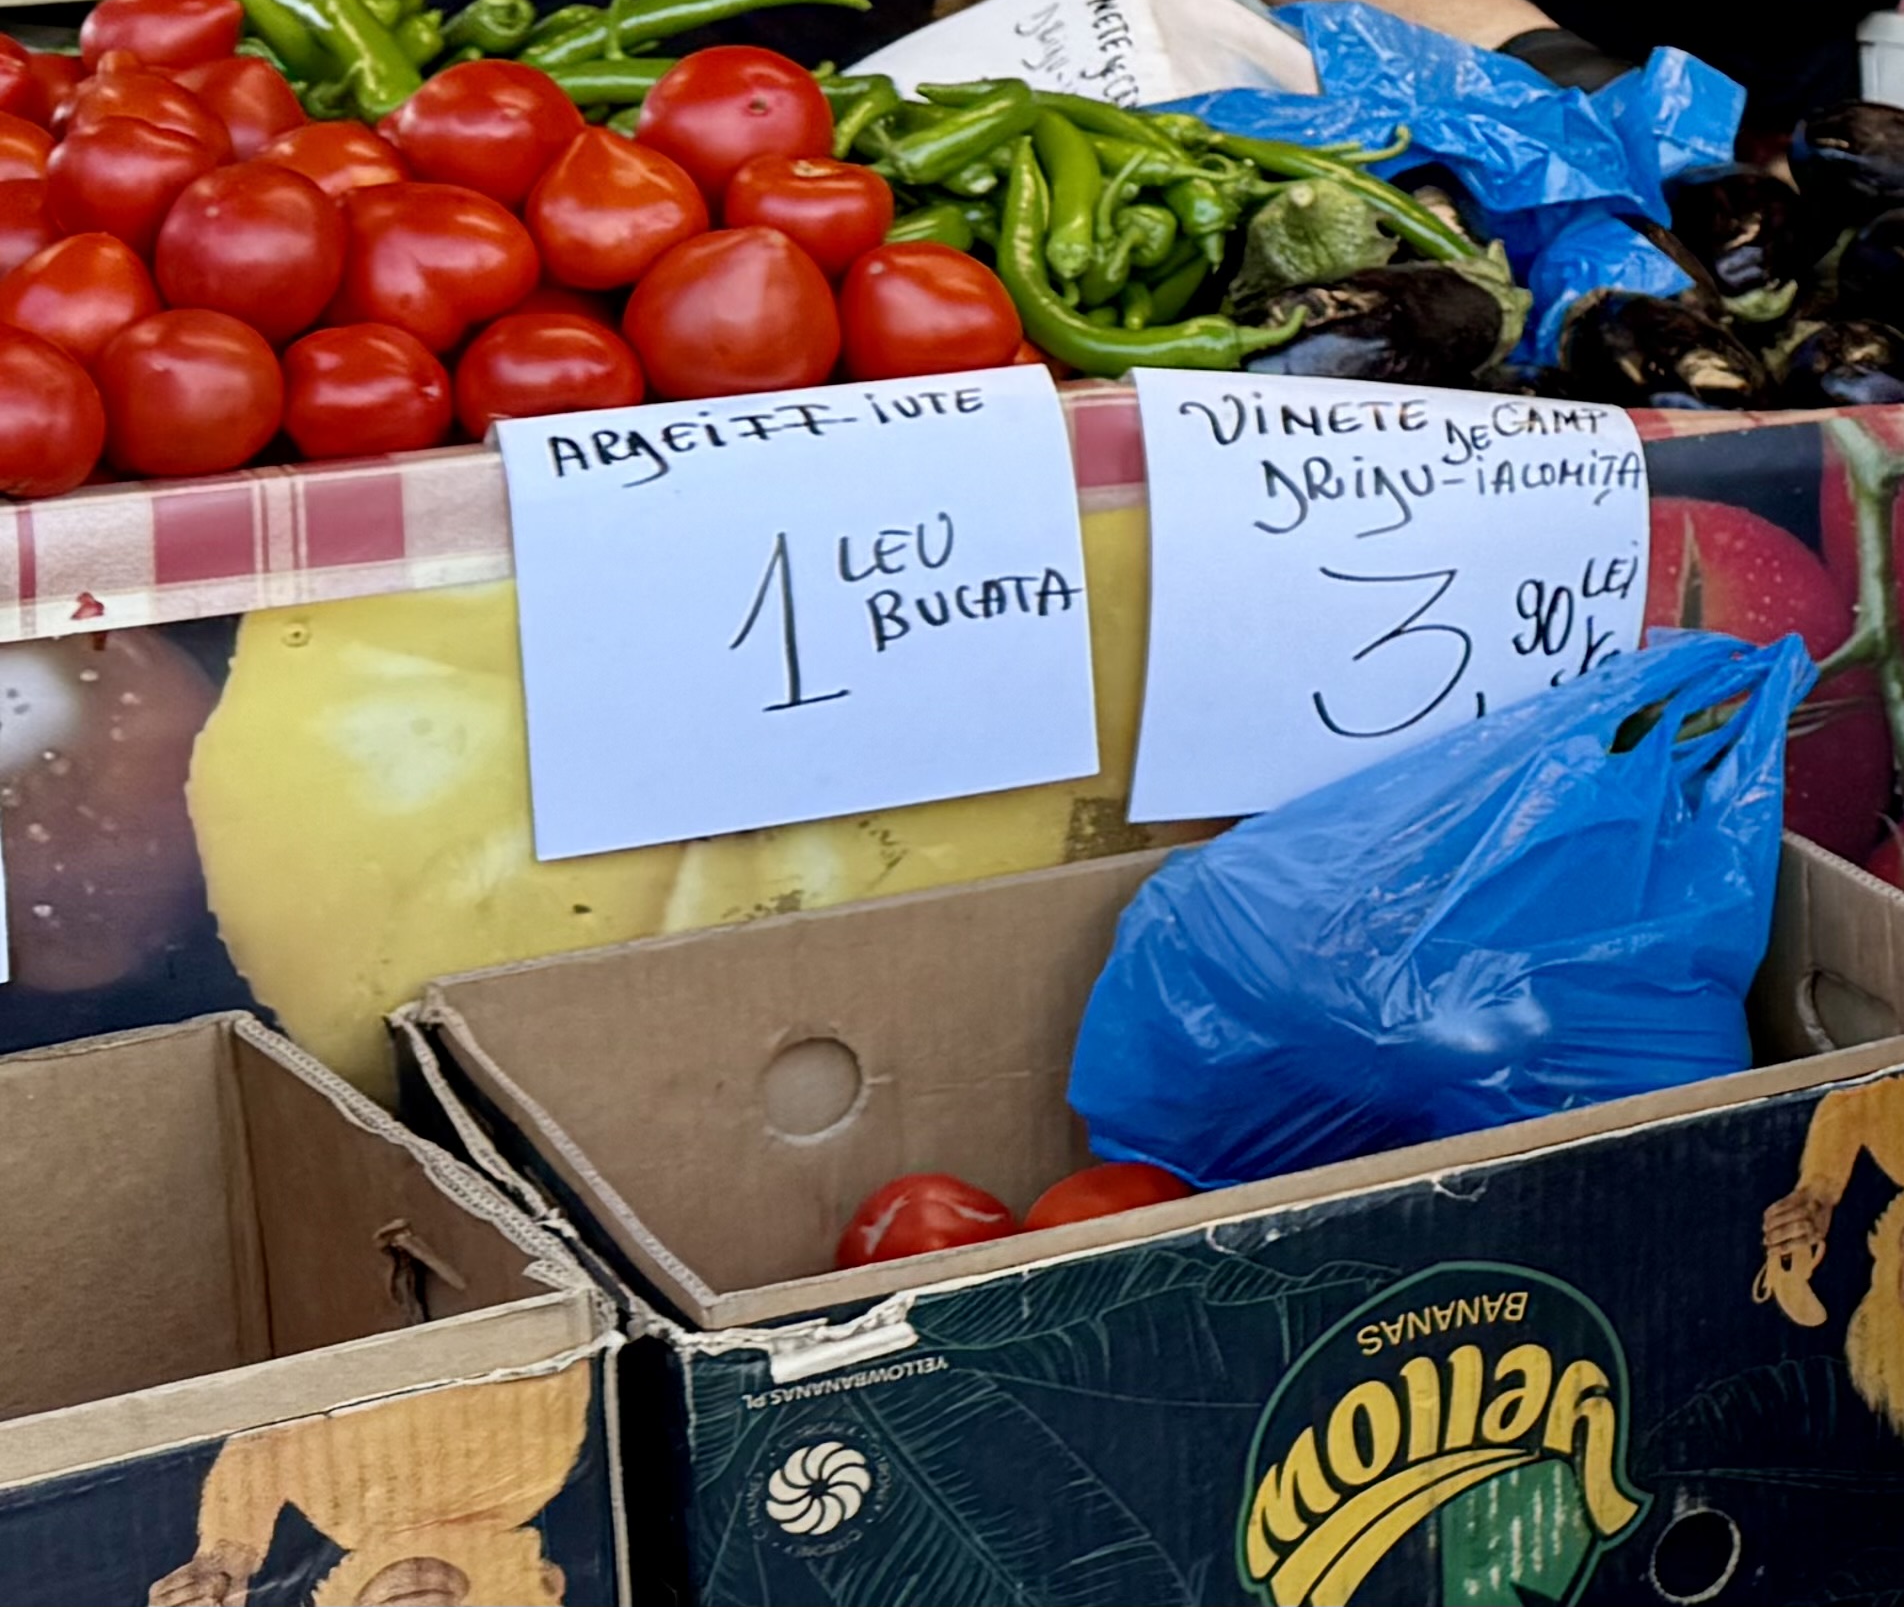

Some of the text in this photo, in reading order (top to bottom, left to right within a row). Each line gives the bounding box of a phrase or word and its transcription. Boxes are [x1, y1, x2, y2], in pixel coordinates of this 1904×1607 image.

[729, 510, 955, 713] 1 LEU
[1356, 1291, 1529, 1356] BANANAS
